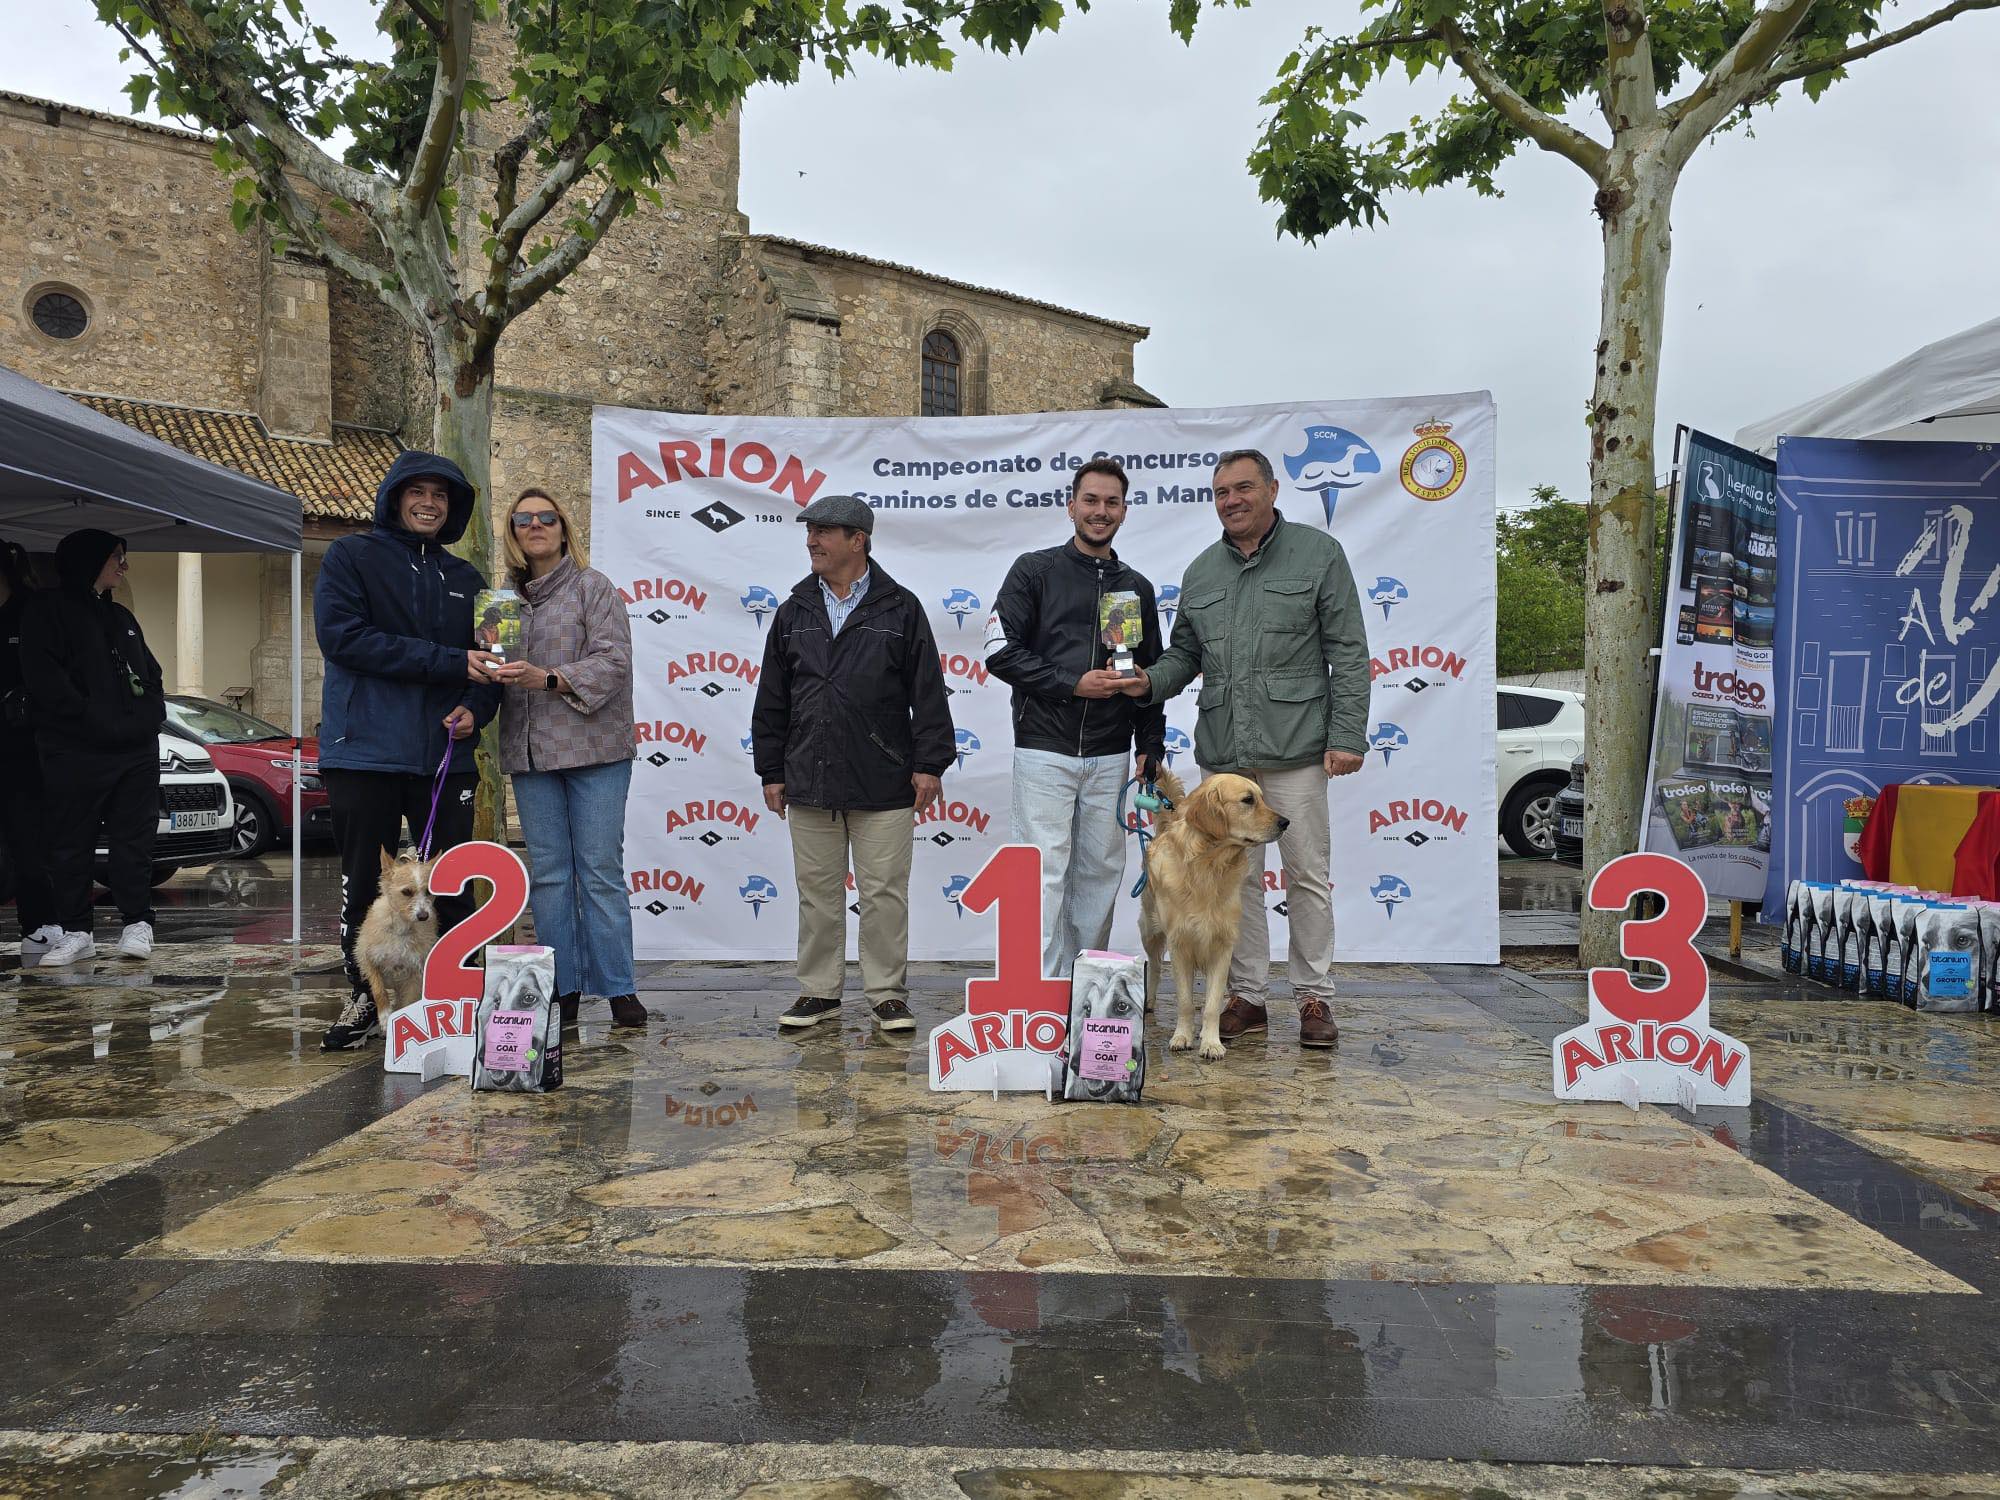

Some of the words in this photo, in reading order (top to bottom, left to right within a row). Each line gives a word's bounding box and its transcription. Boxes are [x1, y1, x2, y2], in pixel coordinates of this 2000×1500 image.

[1313, 431, 1337, 440] SCCM
[617, 438, 828, 508] ARION
[873, 453, 1042, 480] Campeonato
[1050, 452, 1083, 471] de
[1091, 451, 1223, 471] oncurso
[1403, 459, 1411, 476] REAL
[1410, 439, 1448, 457] SOCIEDAD
[1448, 445, 1463, 473] CANINA
[964, 489, 997, 508] de
[1005, 486, 1073, 508] Casti
[1157, 484, 1213, 505] Man
[1415, 487, 1451, 498] ESPAÑA
[646, 510, 681, 519] SINCE
[755, 514, 783, 523] 1980
[667, 651, 760, 685] ARION
[940, 653, 989, 686] ION
[1370, 645, 1467, 682] ARION
[633, 720, 707, 754] RION
[1663, 784, 1706, 798] trofeo
[176, 813, 199, 827] 3887
[200, 812, 216, 826] LTG
[667, 800, 760, 834] ARION
[913, 800, 991, 833] RION
[1369, 799, 1469, 834] ARION
[627, 868, 705, 903] RION
[424, 841, 529, 1001] 2
[961, 846, 1072, 1016] 1
[1589, 853, 1709, 1025] 3
[393, 1000, 477, 1064] ARI
[492, 1015, 532, 1025] titanium
[1086, 1023, 1129, 1034] titanium
[935, 1010, 1070, 1082] ARIO
[1095, 1054, 1118, 1062] COAT
[1561, 1021, 1745, 1091] ARION
